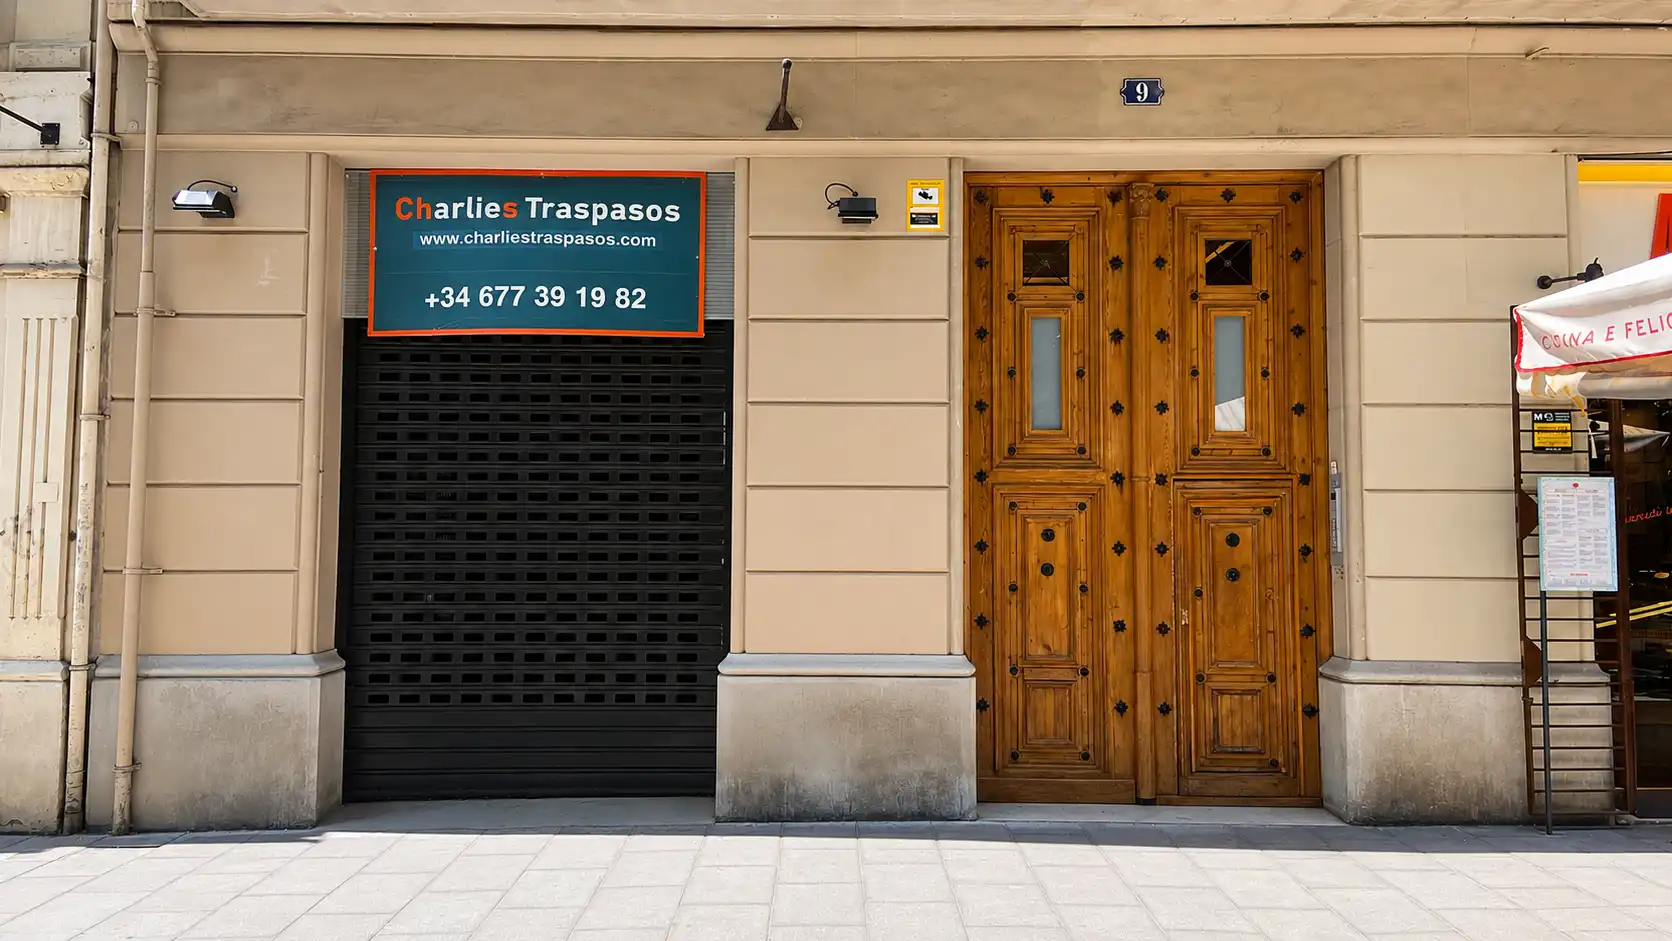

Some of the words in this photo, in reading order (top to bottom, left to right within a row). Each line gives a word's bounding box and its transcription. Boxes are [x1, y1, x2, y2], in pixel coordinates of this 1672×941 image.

[1135, 82, 1149, 102] 9
[395, 196, 518, 221] Charlies
[525, 196, 681, 225] Traspasos
[419, 230, 656, 247] www.charliestraspasos.com
[424, 286, 470, 308] +34
[479, 285, 526, 307] 677
[534, 285, 566, 307] 39
[576, 286, 606, 308] 19
[615, 287, 646, 309] 82
[1605, 325, 1616, 342] E
